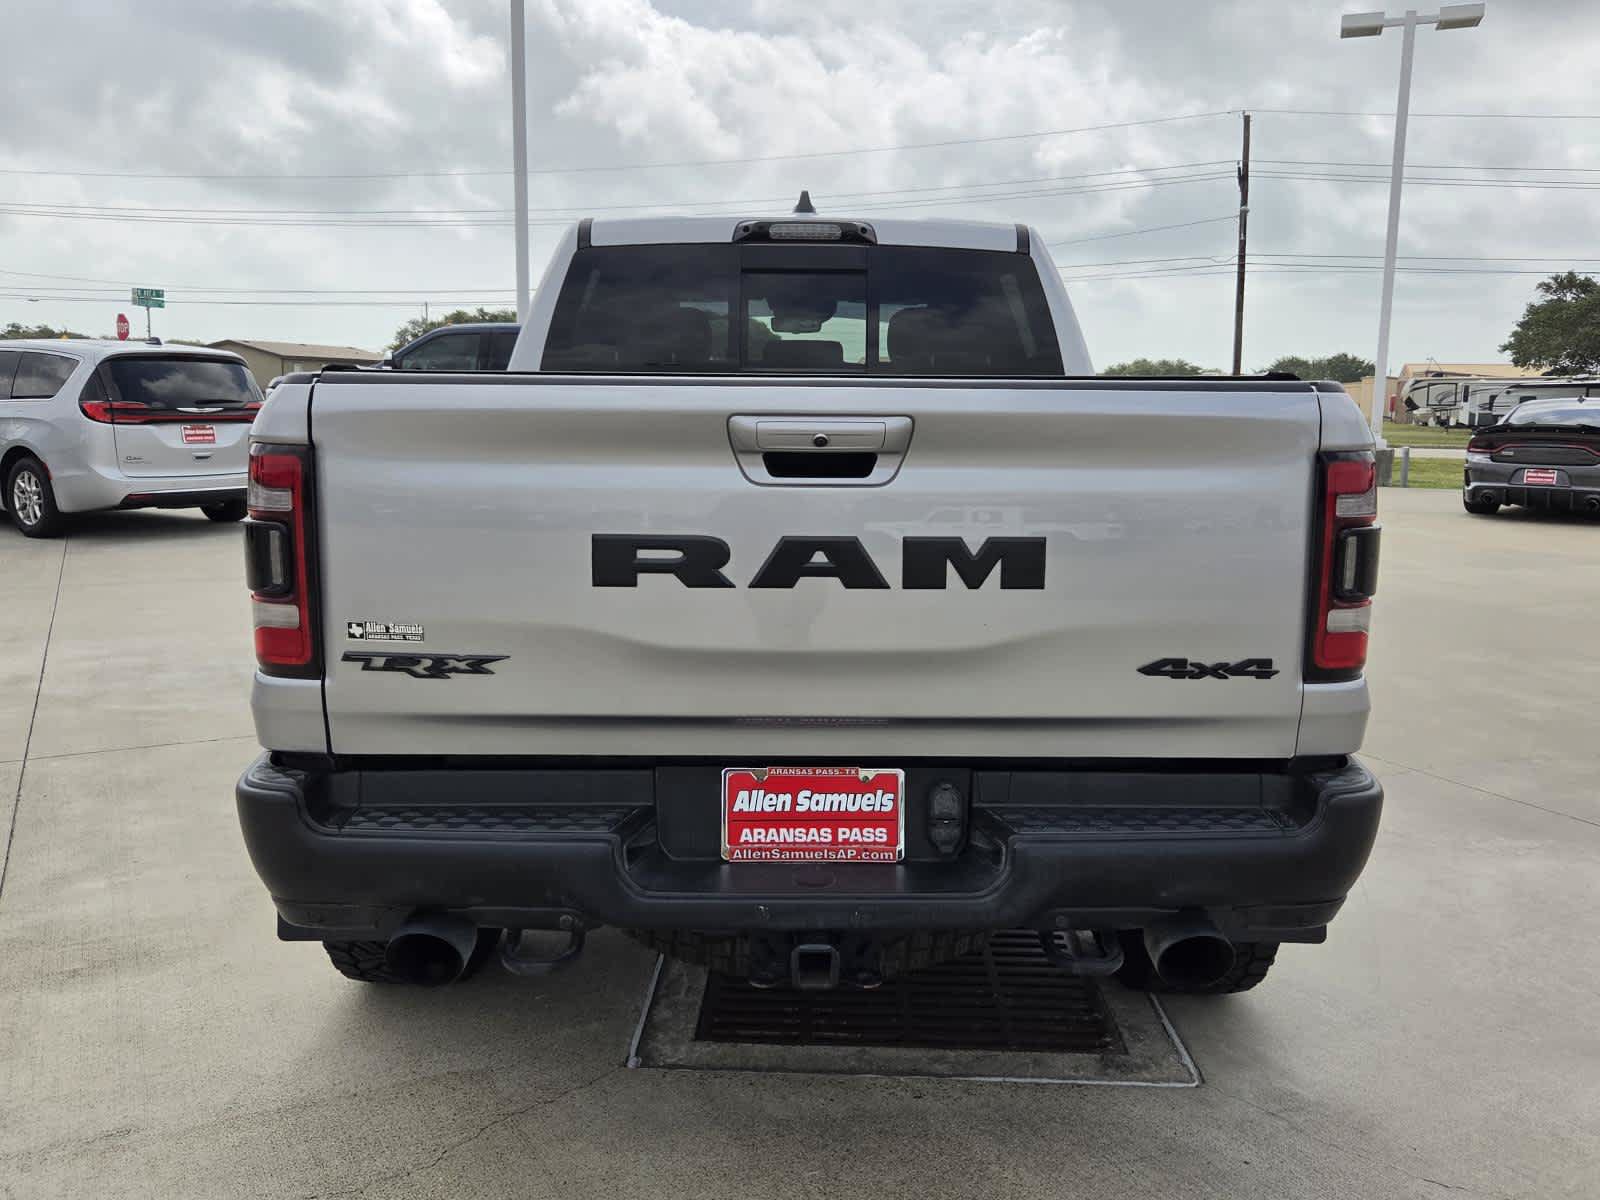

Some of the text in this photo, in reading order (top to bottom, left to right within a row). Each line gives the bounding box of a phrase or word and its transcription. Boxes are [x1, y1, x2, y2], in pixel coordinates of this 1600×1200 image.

[591, 533, 1047, 590] RAM
[365, 622, 423, 634] Allen Samuels
[340, 650, 511, 680] TRX
[1136, 658, 1281, 680] 4x4
[732, 788, 894, 812] Allen Samuels
[739, 827, 888, 843] ARANSAS PASS
[732, 848, 894, 860] AllenSamuelsAP.com
